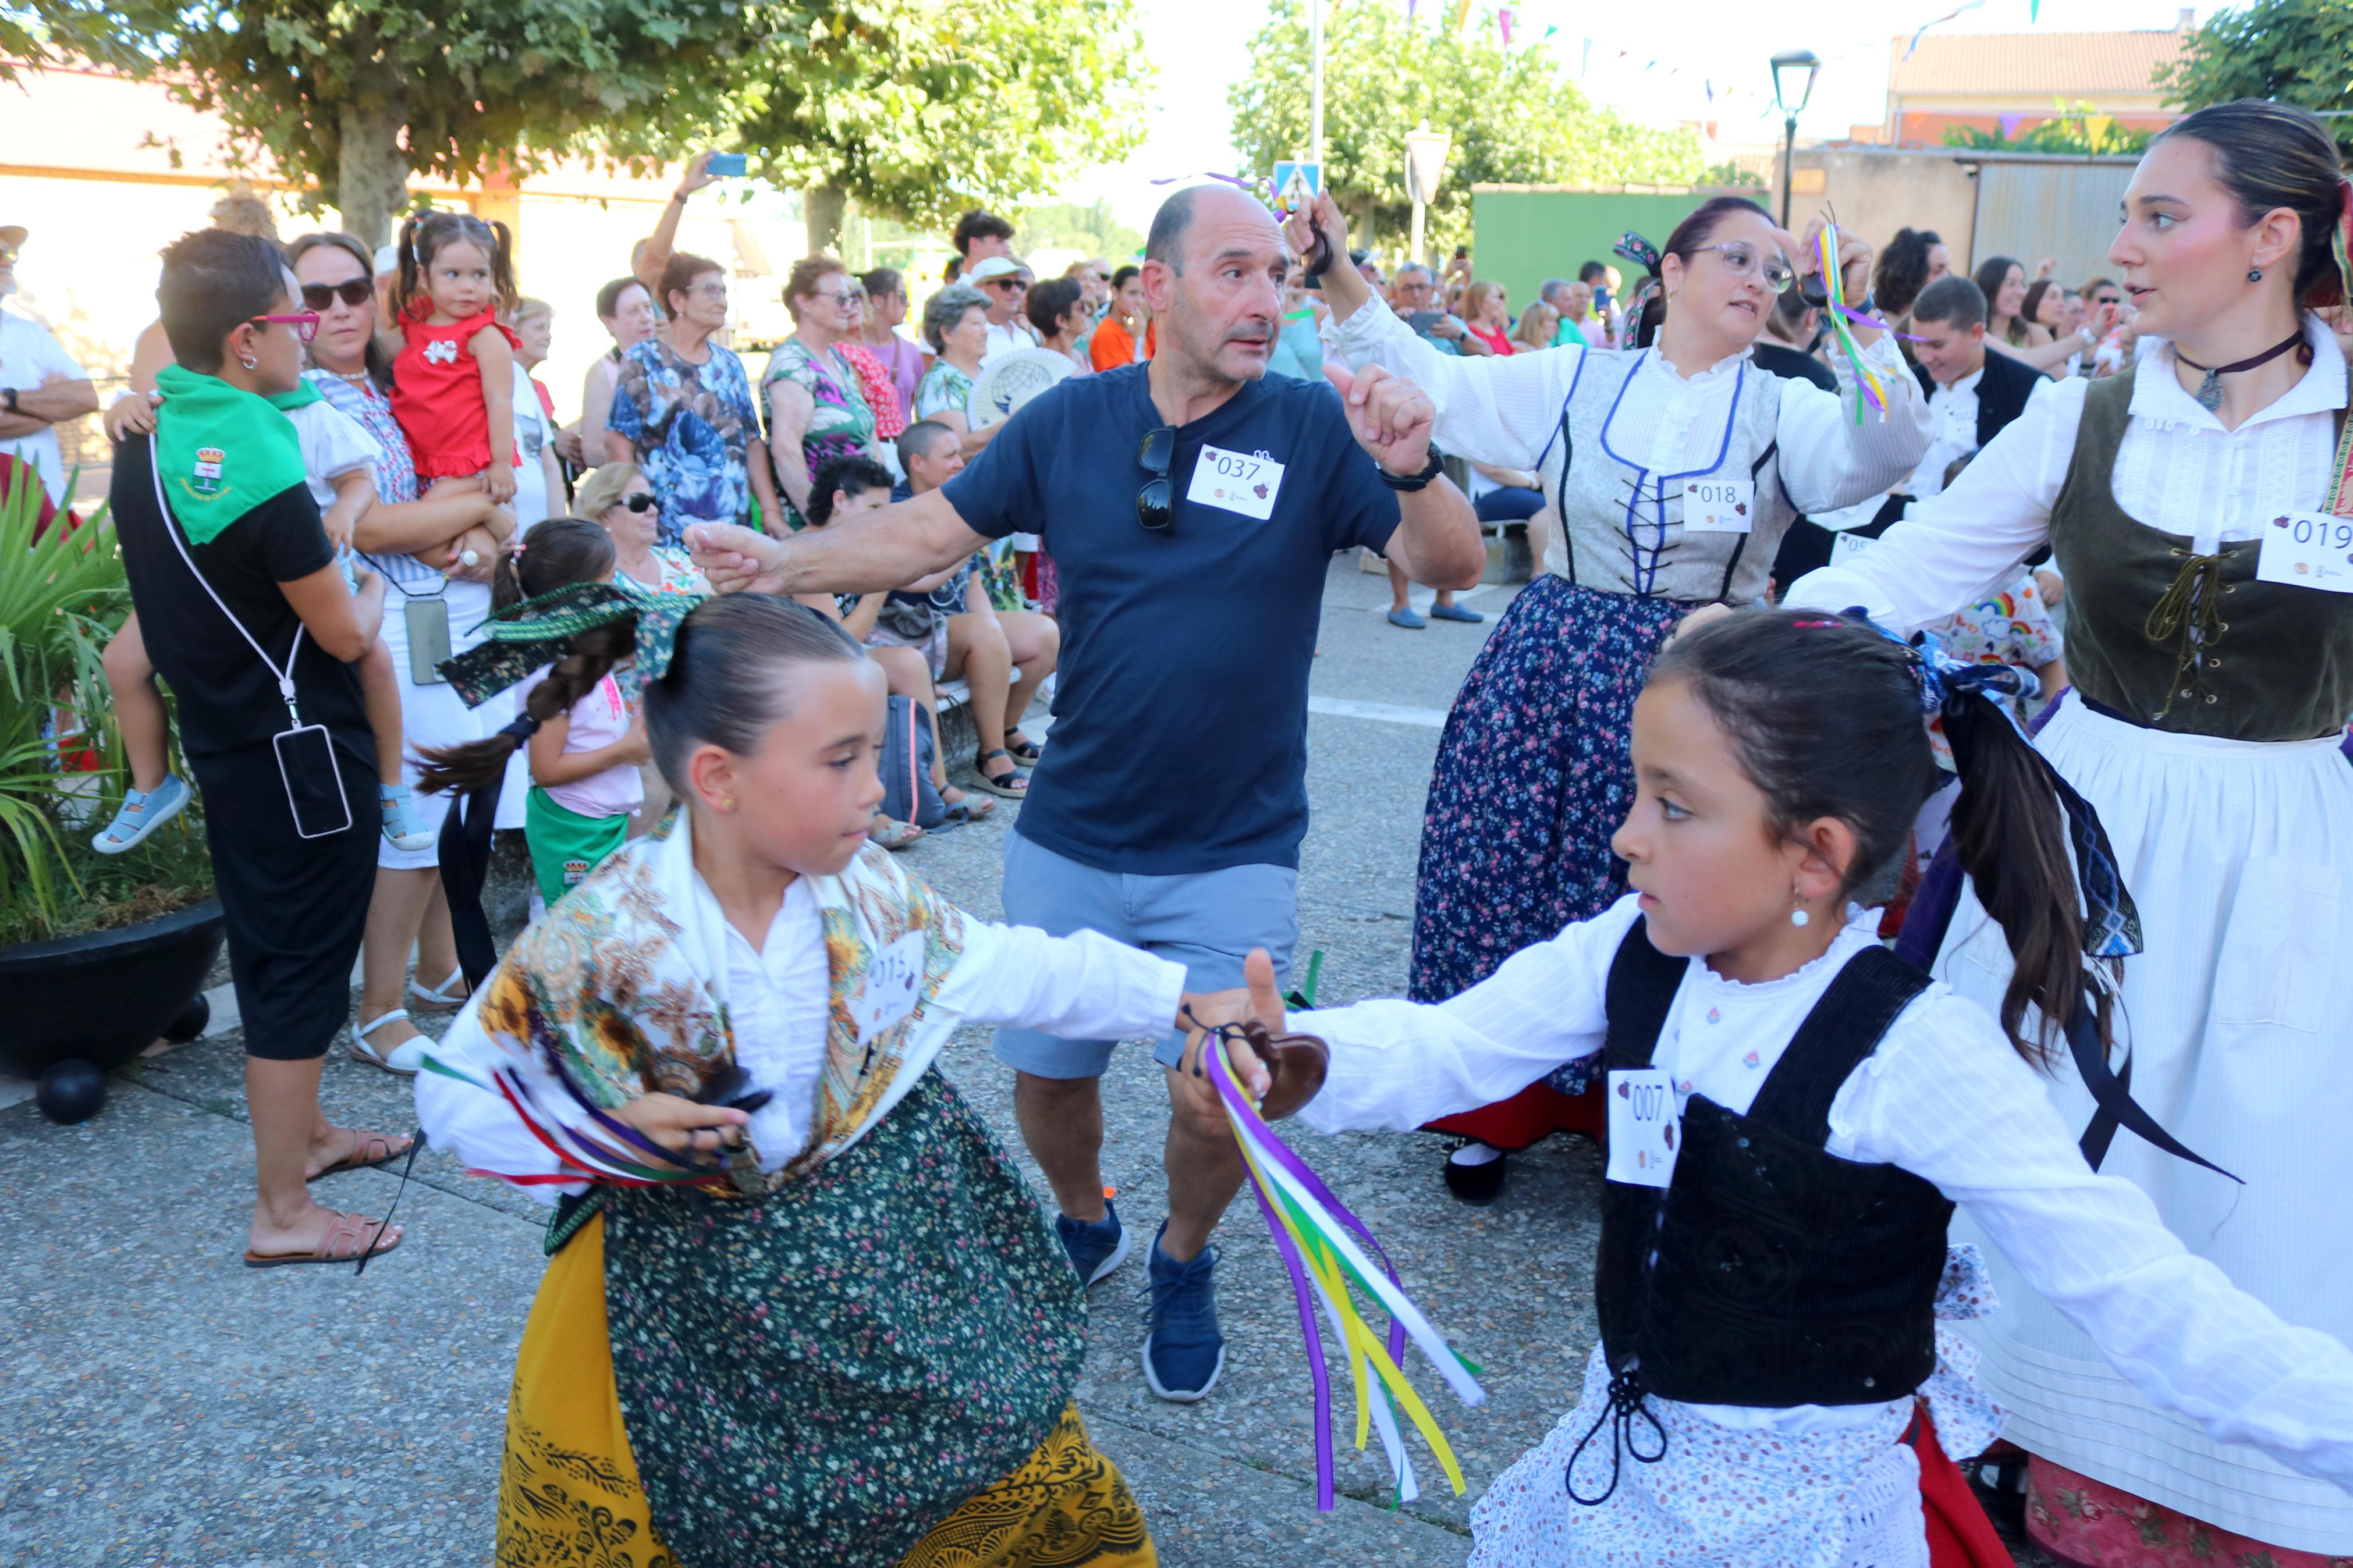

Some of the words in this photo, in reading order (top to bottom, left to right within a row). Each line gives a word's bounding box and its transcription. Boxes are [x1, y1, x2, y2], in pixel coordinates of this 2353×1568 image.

[1218, 457, 1261, 480] 037
[1701, 485, 1736, 503] 018
[1849, 538, 1874, 552] 05
[2294, 520, 2352, 549] 019
[1633, 1085, 1664, 1121] 007
